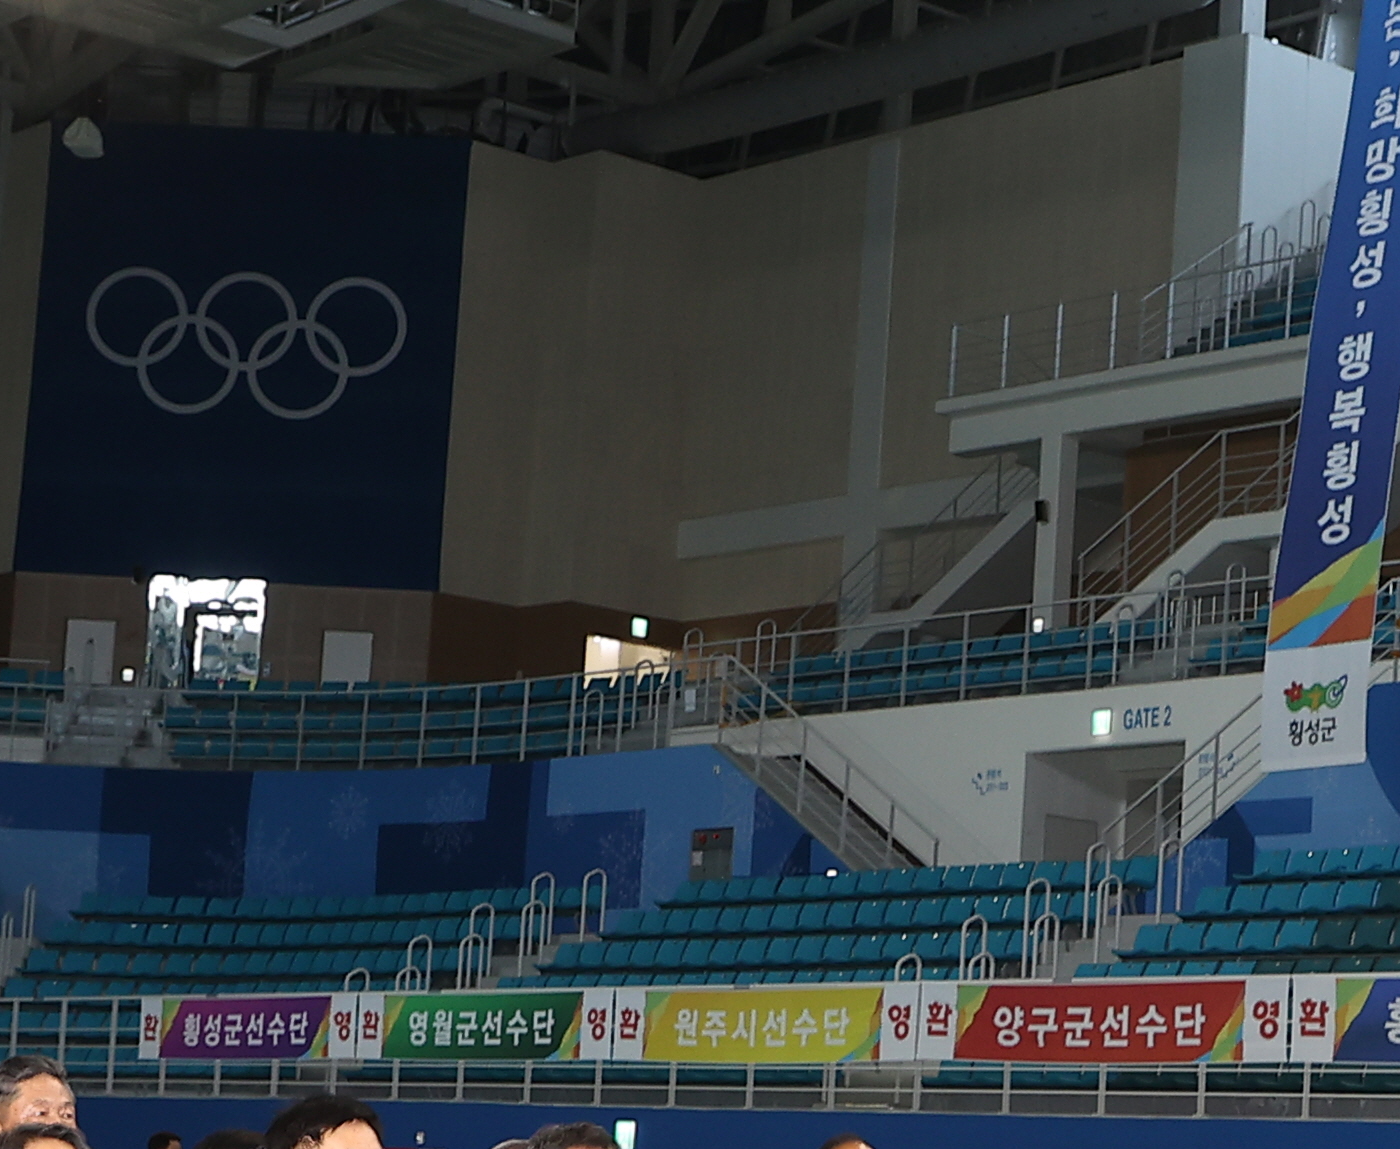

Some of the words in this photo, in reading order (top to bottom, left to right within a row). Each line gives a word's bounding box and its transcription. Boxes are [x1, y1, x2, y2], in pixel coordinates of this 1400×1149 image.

[1317, 331, 1375, 546] 행복횡성
[1123, 706, 1160, 730] GATE
[1163, 705, 1172, 727] 2
[1288, 716, 1337, 747] 횡성군
[182, 1011, 309, 1047] 횡성군선수단
[334, 1010, 351, 1041] 영
[362, 1010, 380, 1040] 환
[409, 1008, 556, 1047] 영월군선수단
[587, 1007, 606, 1041] 영
[619, 1006, 641, 1039] 환
[674, 1007, 850, 1048] 원주시선수단
[888, 1003, 911, 1041] 영
[926, 1001, 952, 1037] 환
[993, 1003, 1207, 1049] 양구군선수단
[1252, 999, 1281, 1040] 영
[1299, 998, 1330, 1037] 환
